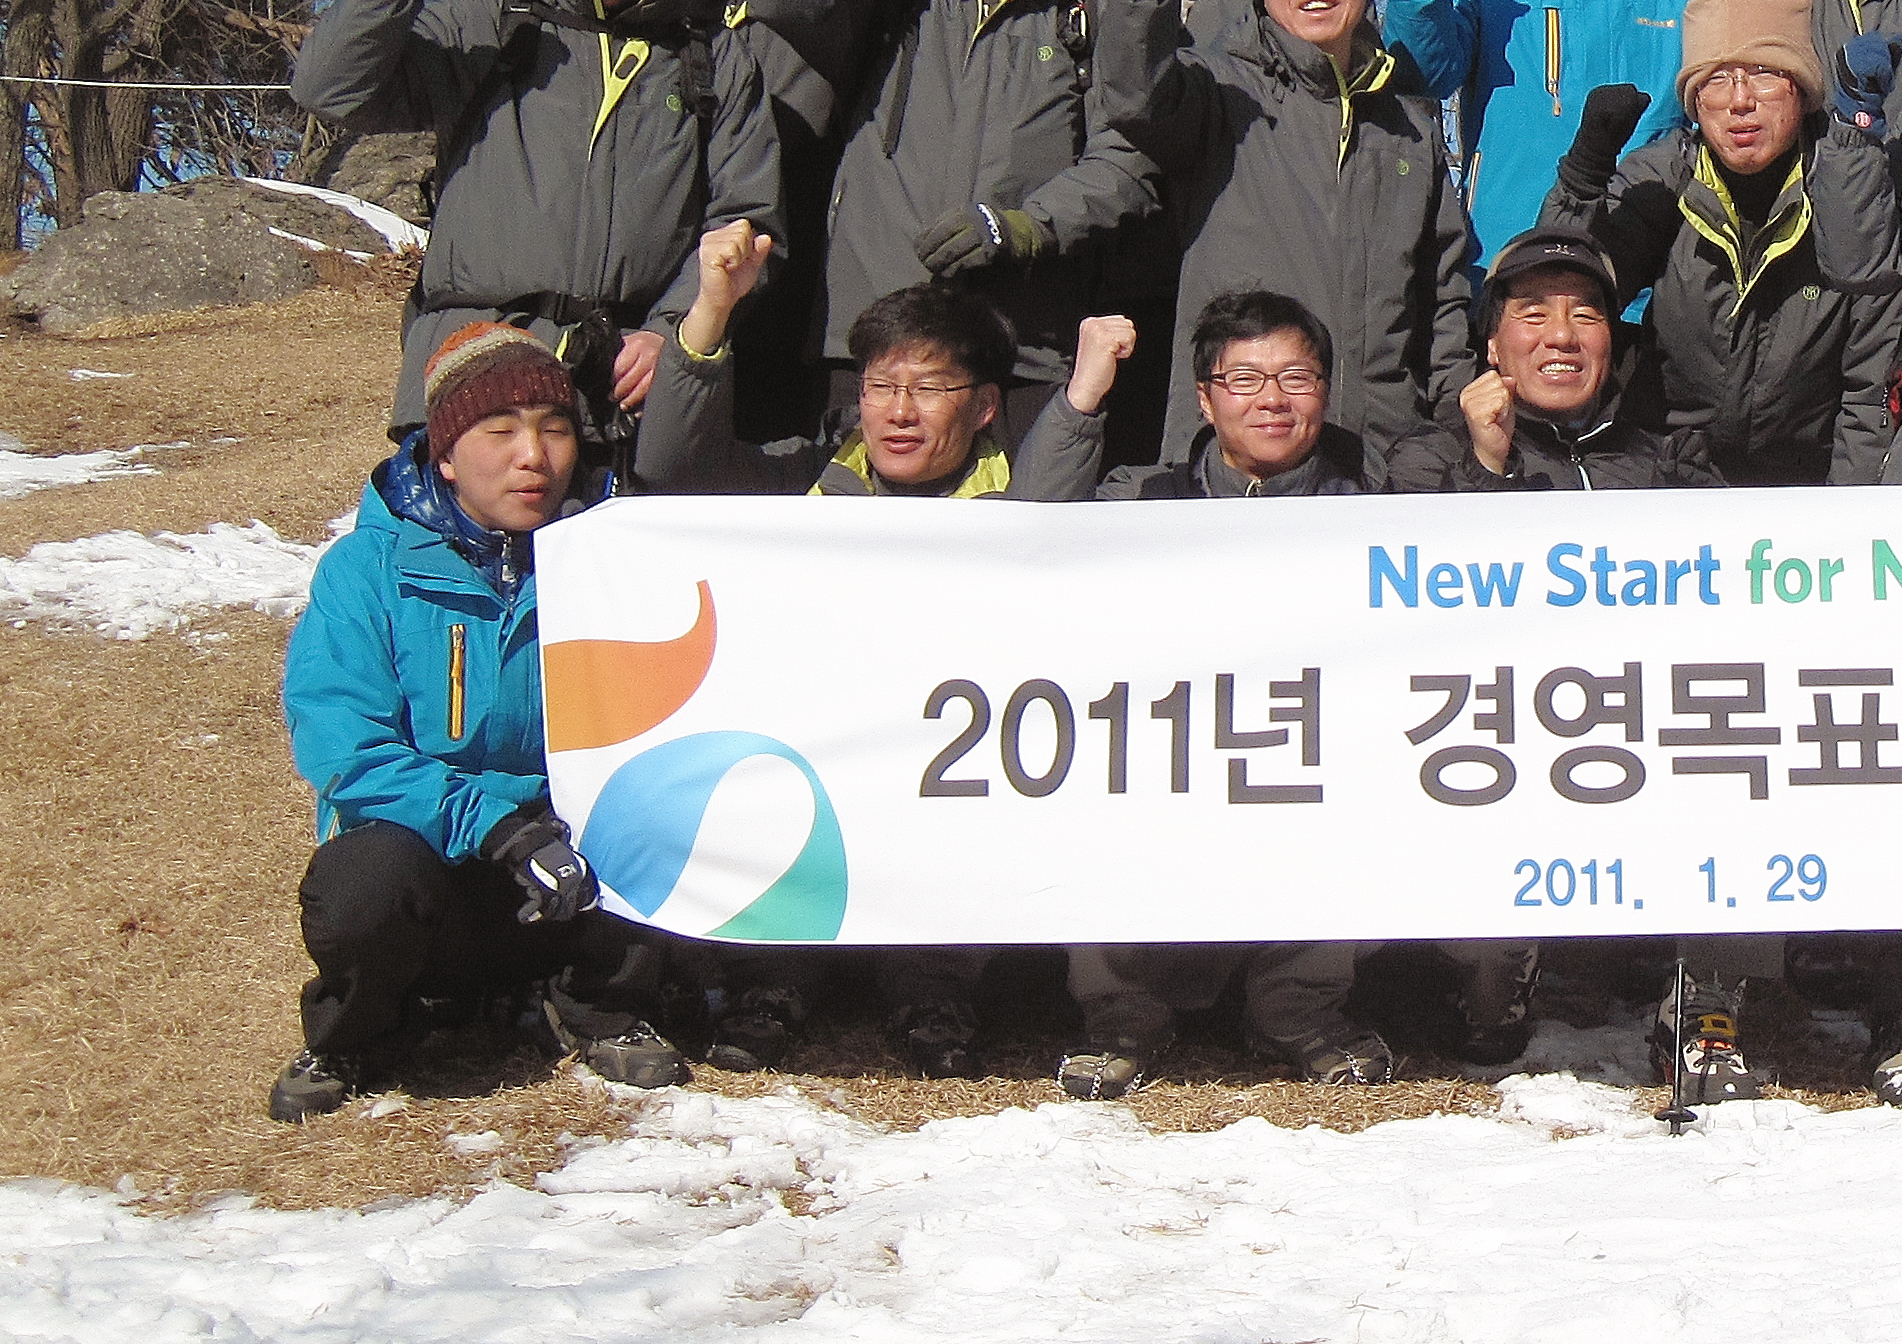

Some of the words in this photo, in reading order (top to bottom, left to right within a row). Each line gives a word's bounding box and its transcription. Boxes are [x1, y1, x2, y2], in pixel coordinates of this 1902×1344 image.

[1368, 544, 1524, 609] New
[1545, 542, 1721, 608] Start
[1744, 538, 1845, 605] for
[918, 666, 1324, 805] 2011년
[1513, 858, 1644, 910] 2011.
[1698, 856, 1737, 908] 1.
[1766, 853, 1828, 902] 29
